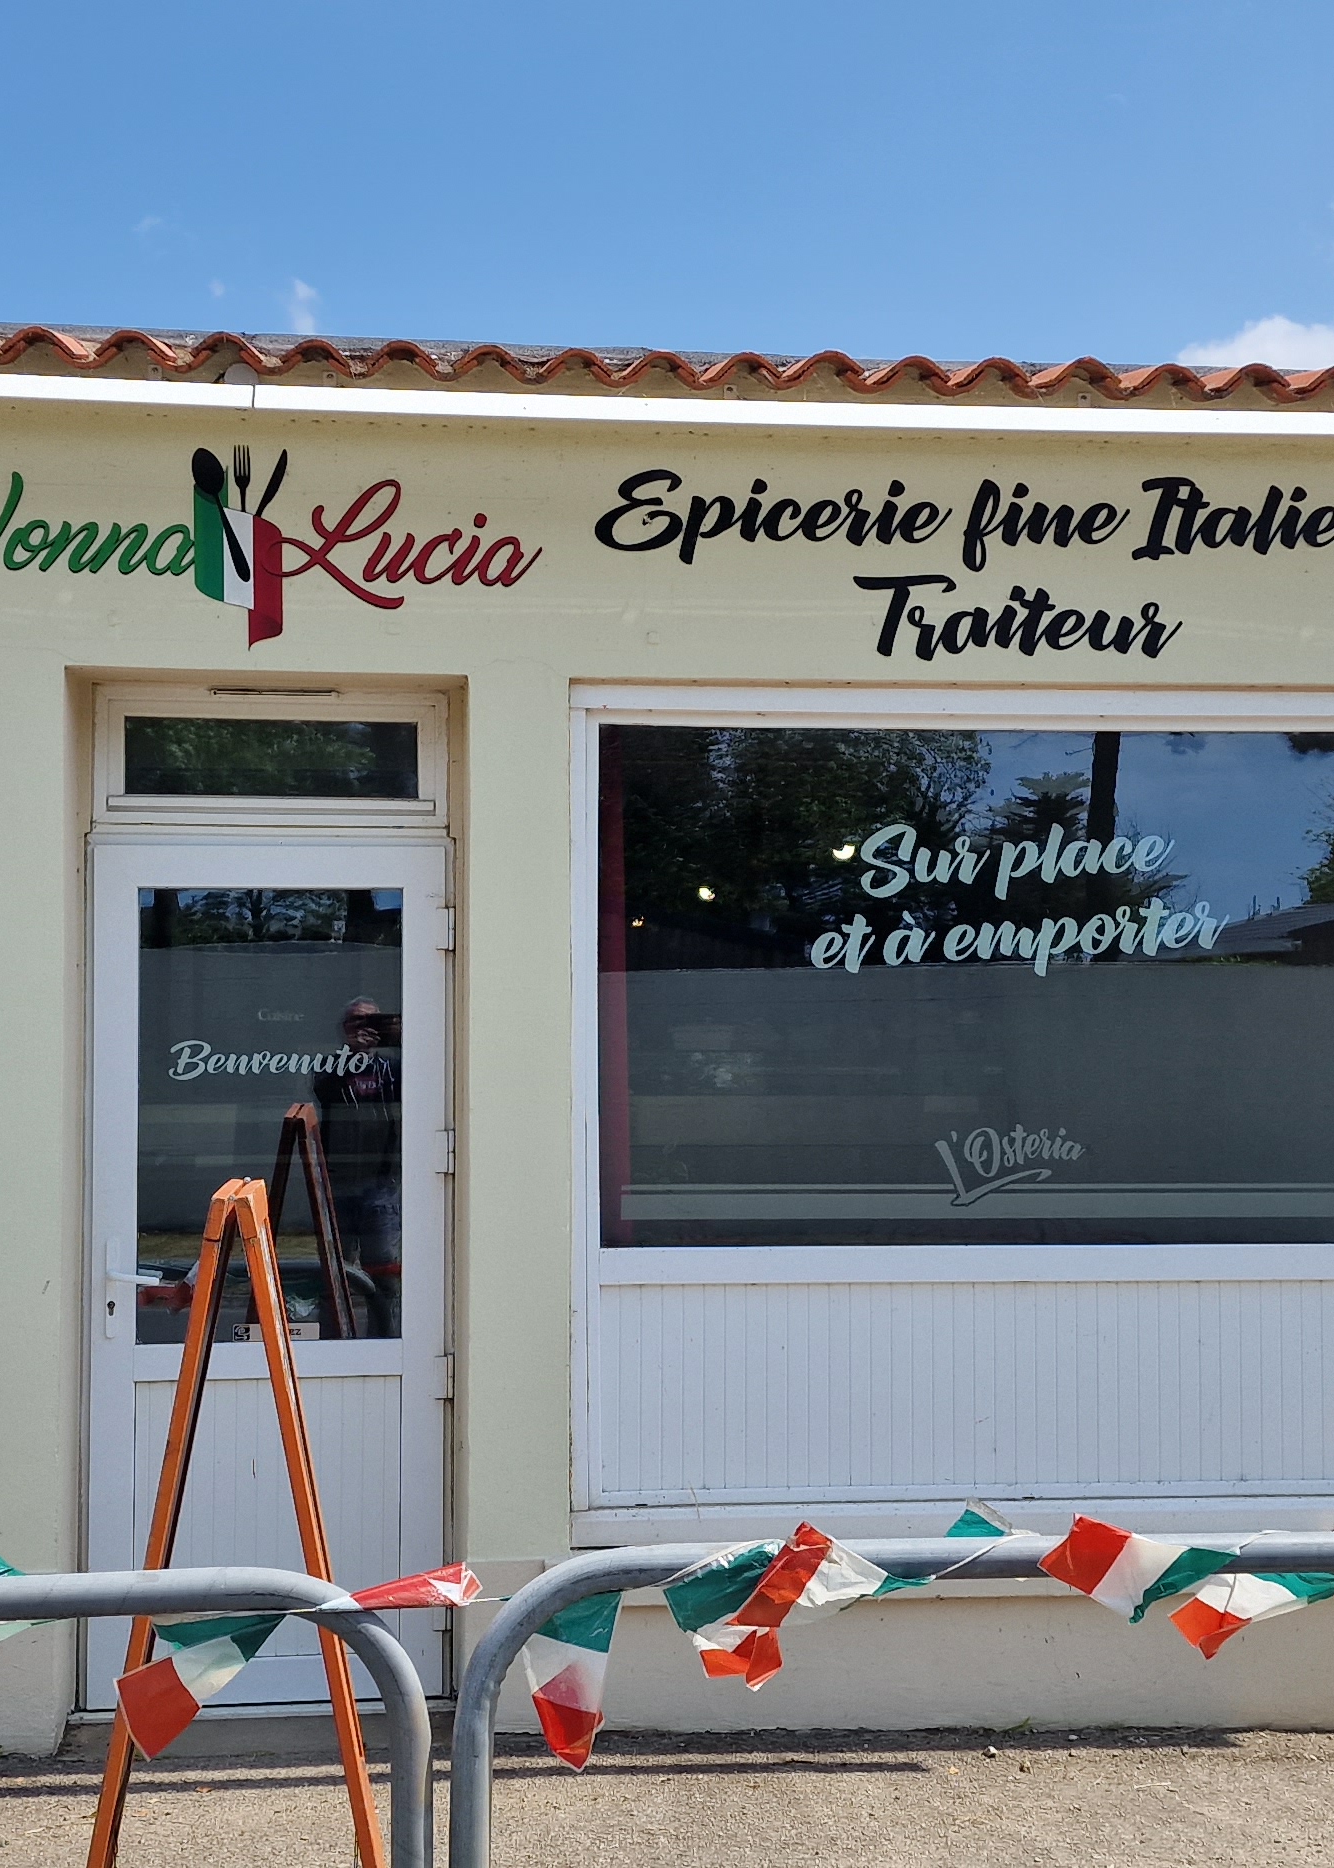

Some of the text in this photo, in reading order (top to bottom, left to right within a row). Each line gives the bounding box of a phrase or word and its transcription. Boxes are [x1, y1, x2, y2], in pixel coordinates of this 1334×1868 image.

[261, 479, 543, 610] Lucia
[594, 468, 952, 565] Epicerie
[962, 478, 1132, 572] fine
[860, 822, 1175, 900] Sur place
[809, 897, 1230, 977] et à emporter
[168, 1039, 374, 1081] Benvenuto
[934, 1123, 1087, 1207] L'Osteria
